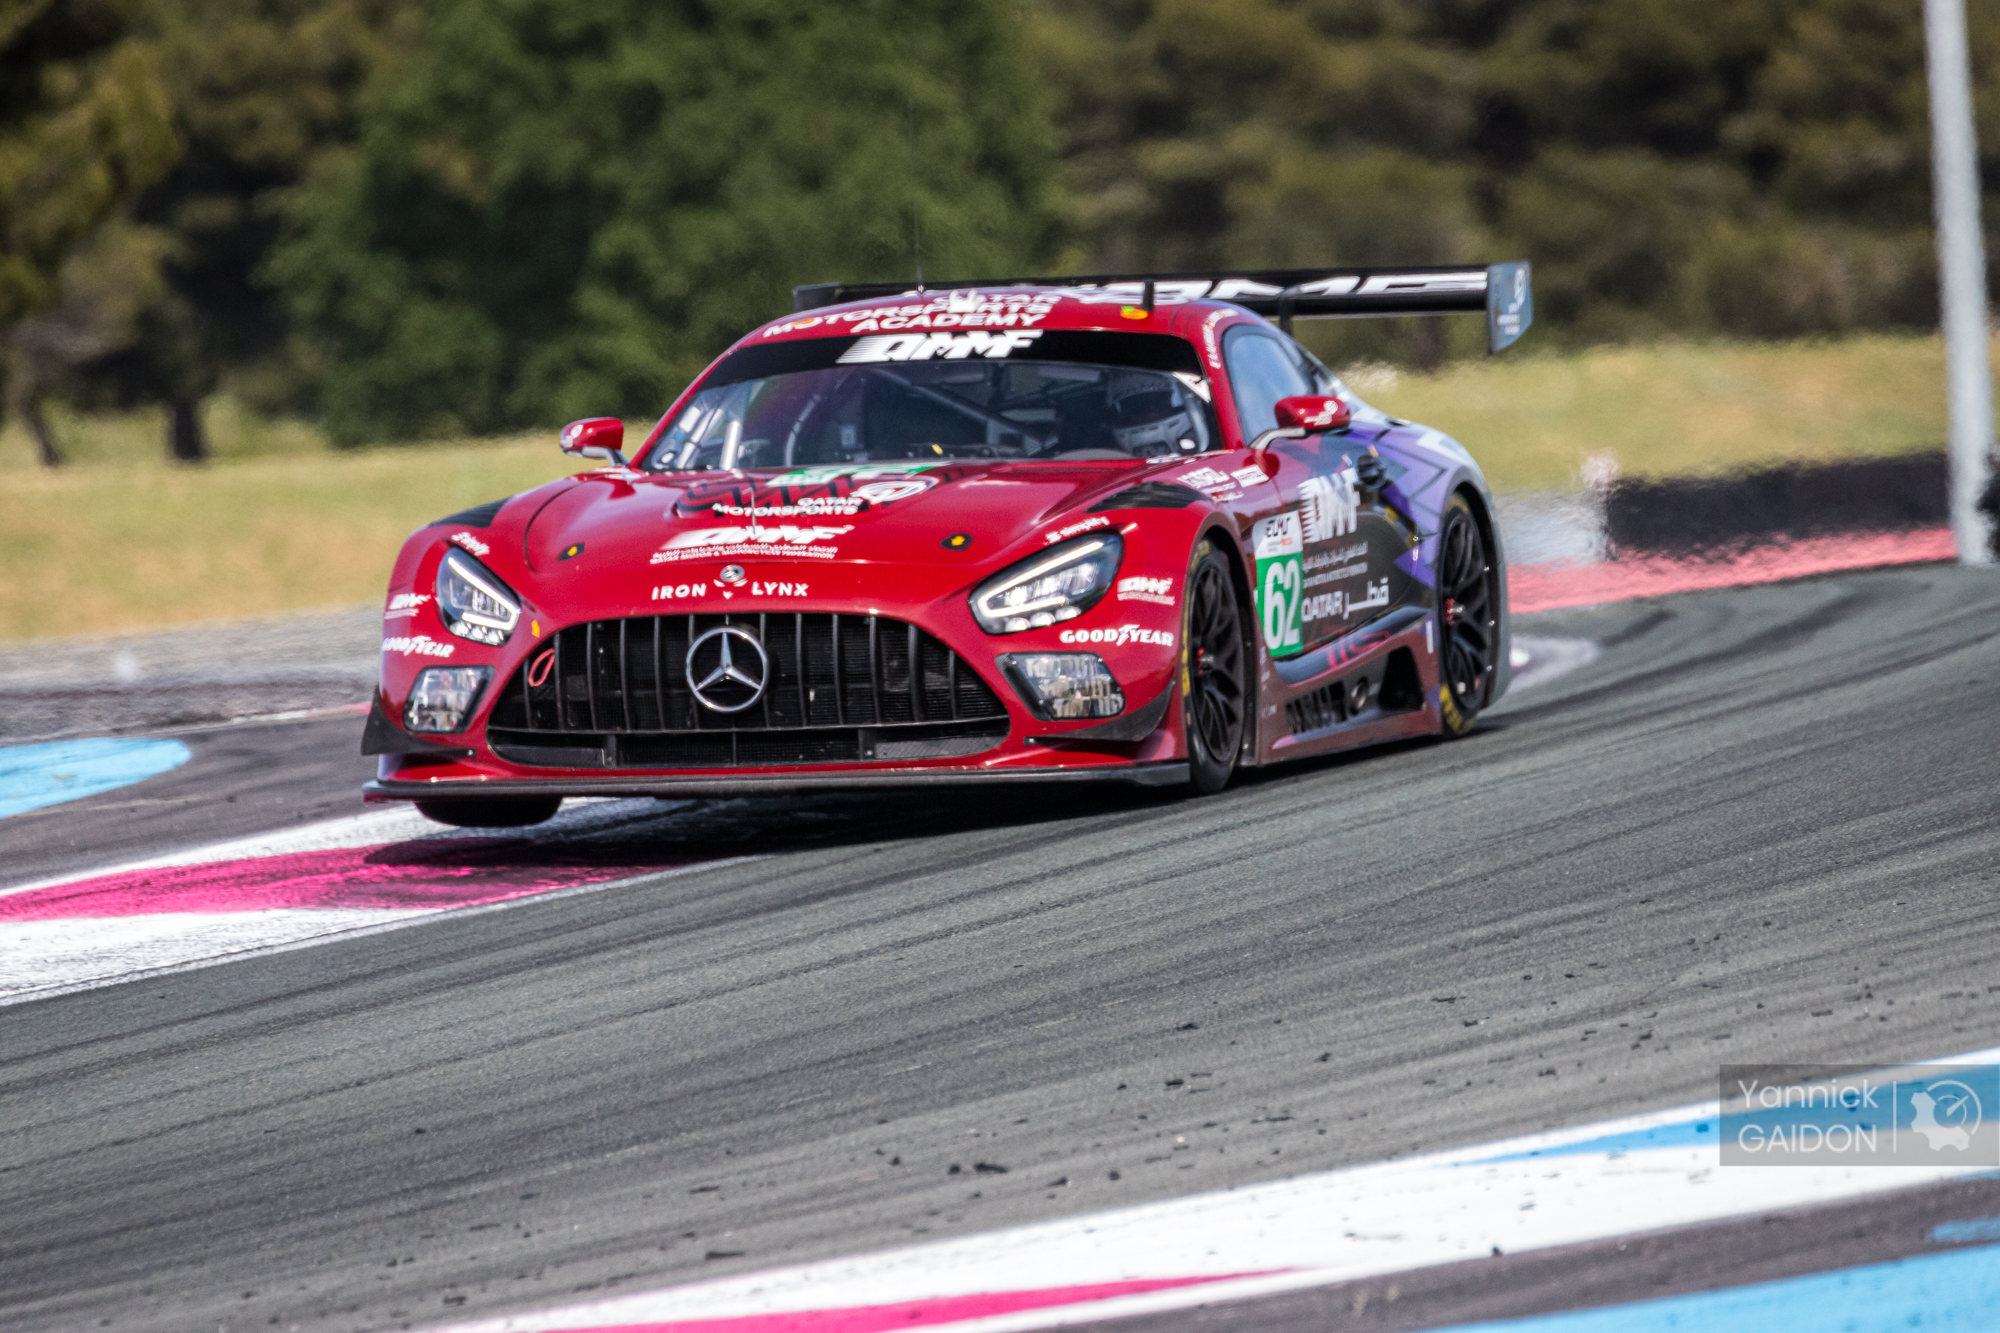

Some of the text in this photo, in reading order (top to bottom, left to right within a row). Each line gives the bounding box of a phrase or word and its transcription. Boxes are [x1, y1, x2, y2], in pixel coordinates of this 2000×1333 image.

[763, 302, 1053, 337] MOTORSPRTS
[850, 313, 1046, 333] ACADEMY
[712, 503, 858, 517] MOTORSPORTS
[798, 497, 863, 507] QATAR
[652, 583, 706, 600] IRON
[752, 581, 809, 597] LYNX
[1264, 558, 1300, 650] 62
[1302, 590, 1343, 622] QATAR
[1060, 624, 1174, 647] GOODYEAR
[382, 635, 455, 658] GOODYEAR
